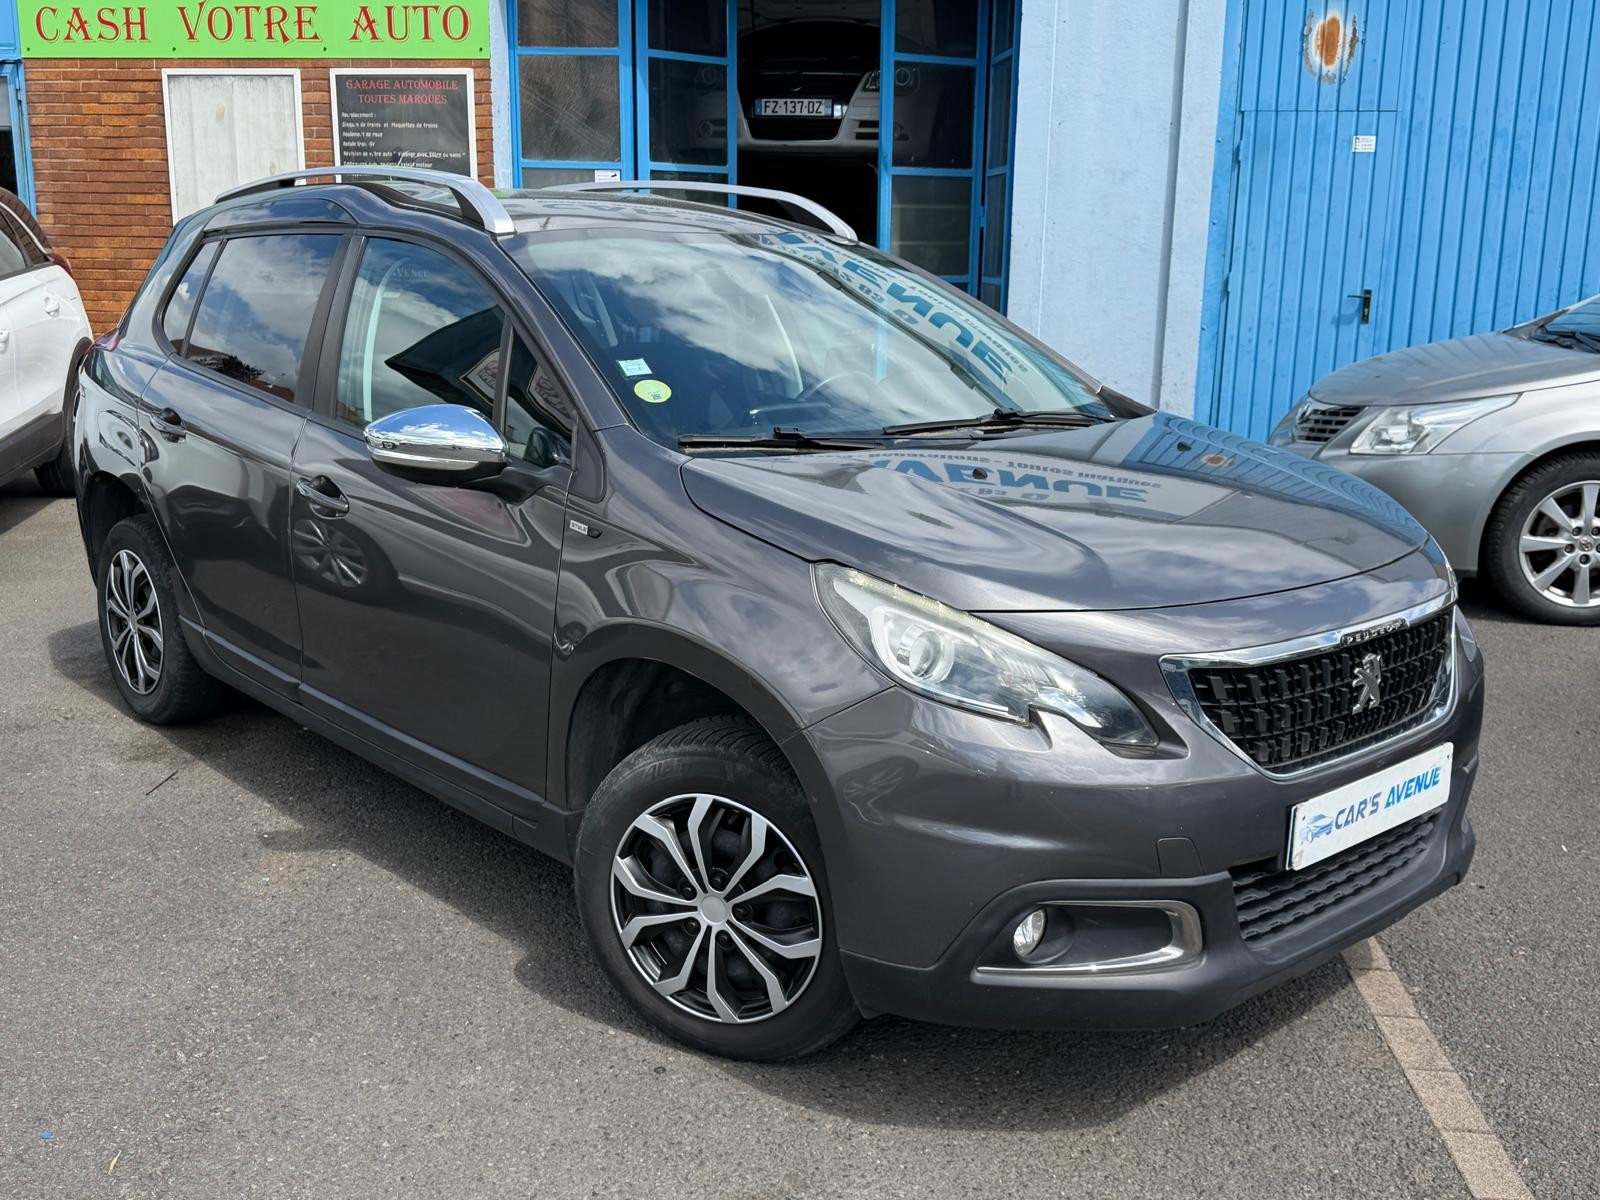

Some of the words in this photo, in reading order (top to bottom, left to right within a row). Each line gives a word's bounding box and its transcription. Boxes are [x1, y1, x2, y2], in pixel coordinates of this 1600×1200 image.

[35, 6, 151, 43] CASH
[176, 0, 322, 45] VOTRE
[349, 5, 474, 43] AUTO
[345, 79, 391, 90] GARAGE
[393, 80, 460, 91] AUTOMOBILE
[358, 94, 397, 104] TOUTES
[398, 94, 449, 105] MARQUES
[763, 100, 824, 114] FZ-137-DZ
[1346, 621, 1401, 645] PEUGEOT
[1334, 792, 1383, 830] CAR'S
[1384, 766, 1442, 809] AVENUE
